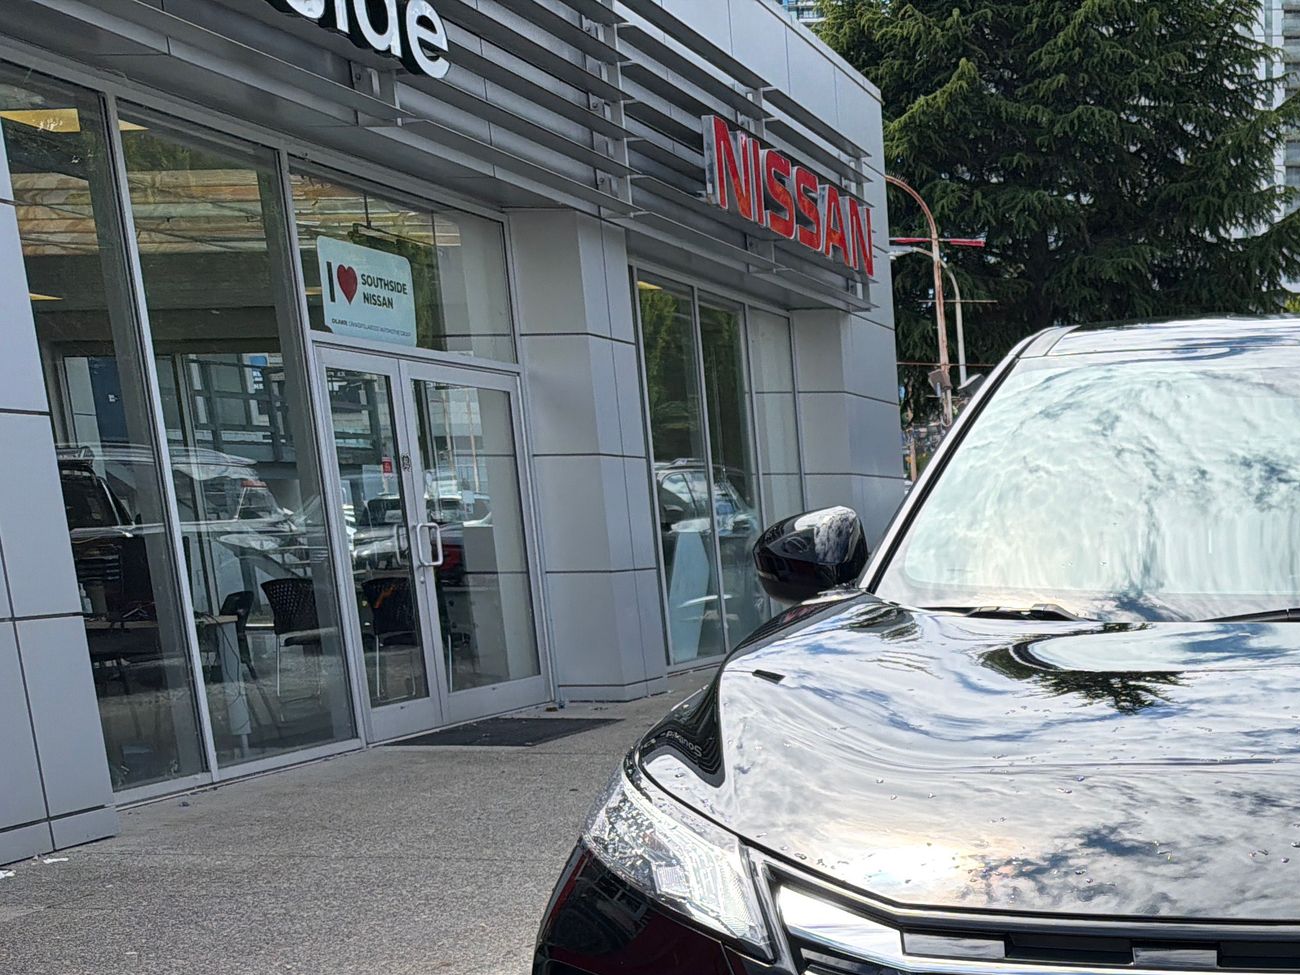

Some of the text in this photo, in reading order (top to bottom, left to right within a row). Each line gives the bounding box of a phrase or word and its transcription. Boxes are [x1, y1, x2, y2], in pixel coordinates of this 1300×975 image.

[705, 115, 875, 279] NISSAN
[326, 261, 408, 303] I SOUTHSIDE
[363, 292, 394, 309] NISSAN
